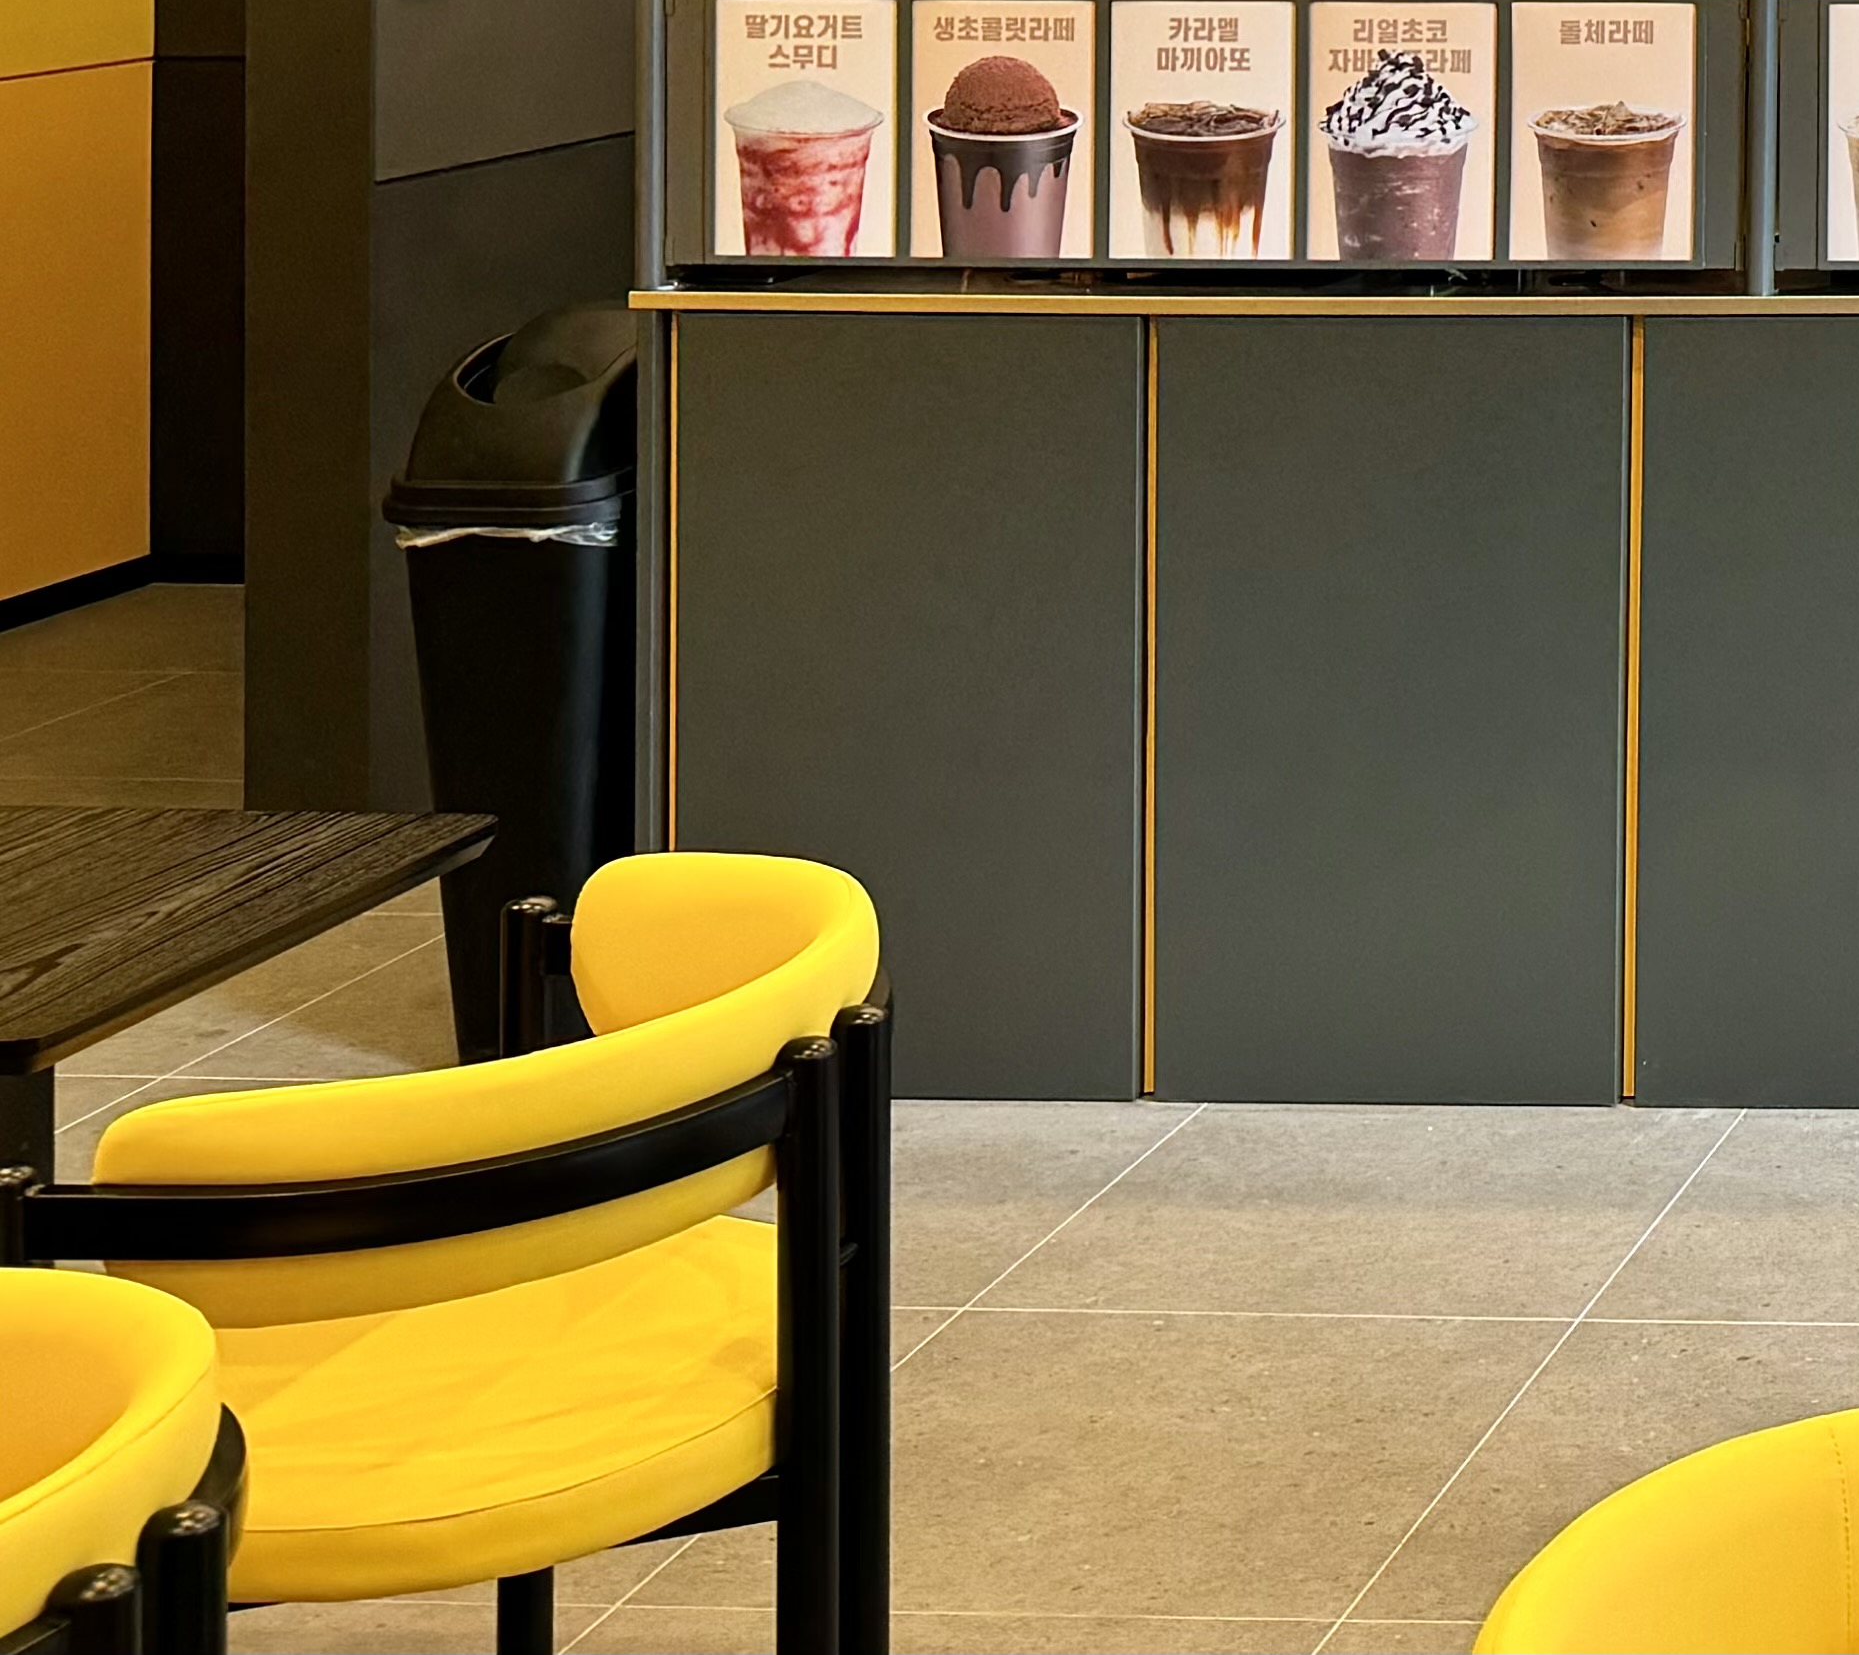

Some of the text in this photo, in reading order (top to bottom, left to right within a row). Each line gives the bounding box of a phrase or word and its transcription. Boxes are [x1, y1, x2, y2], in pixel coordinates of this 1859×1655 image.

[744, 14, 863, 40] 딸기요거트
[933, 16, 1075, 42] 생초콜릿라떼
[1168, 17, 1239, 42] 카라멜
[1353, 18, 1448, 44] 리얼초코
[1559, 19, 1654, 45] 돌체라떼
[768, 44, 838, 70] 스무디
[1156, 47, 1251, 73] 마끼아또
[1328, 48, 1471, 74] 자바라페
